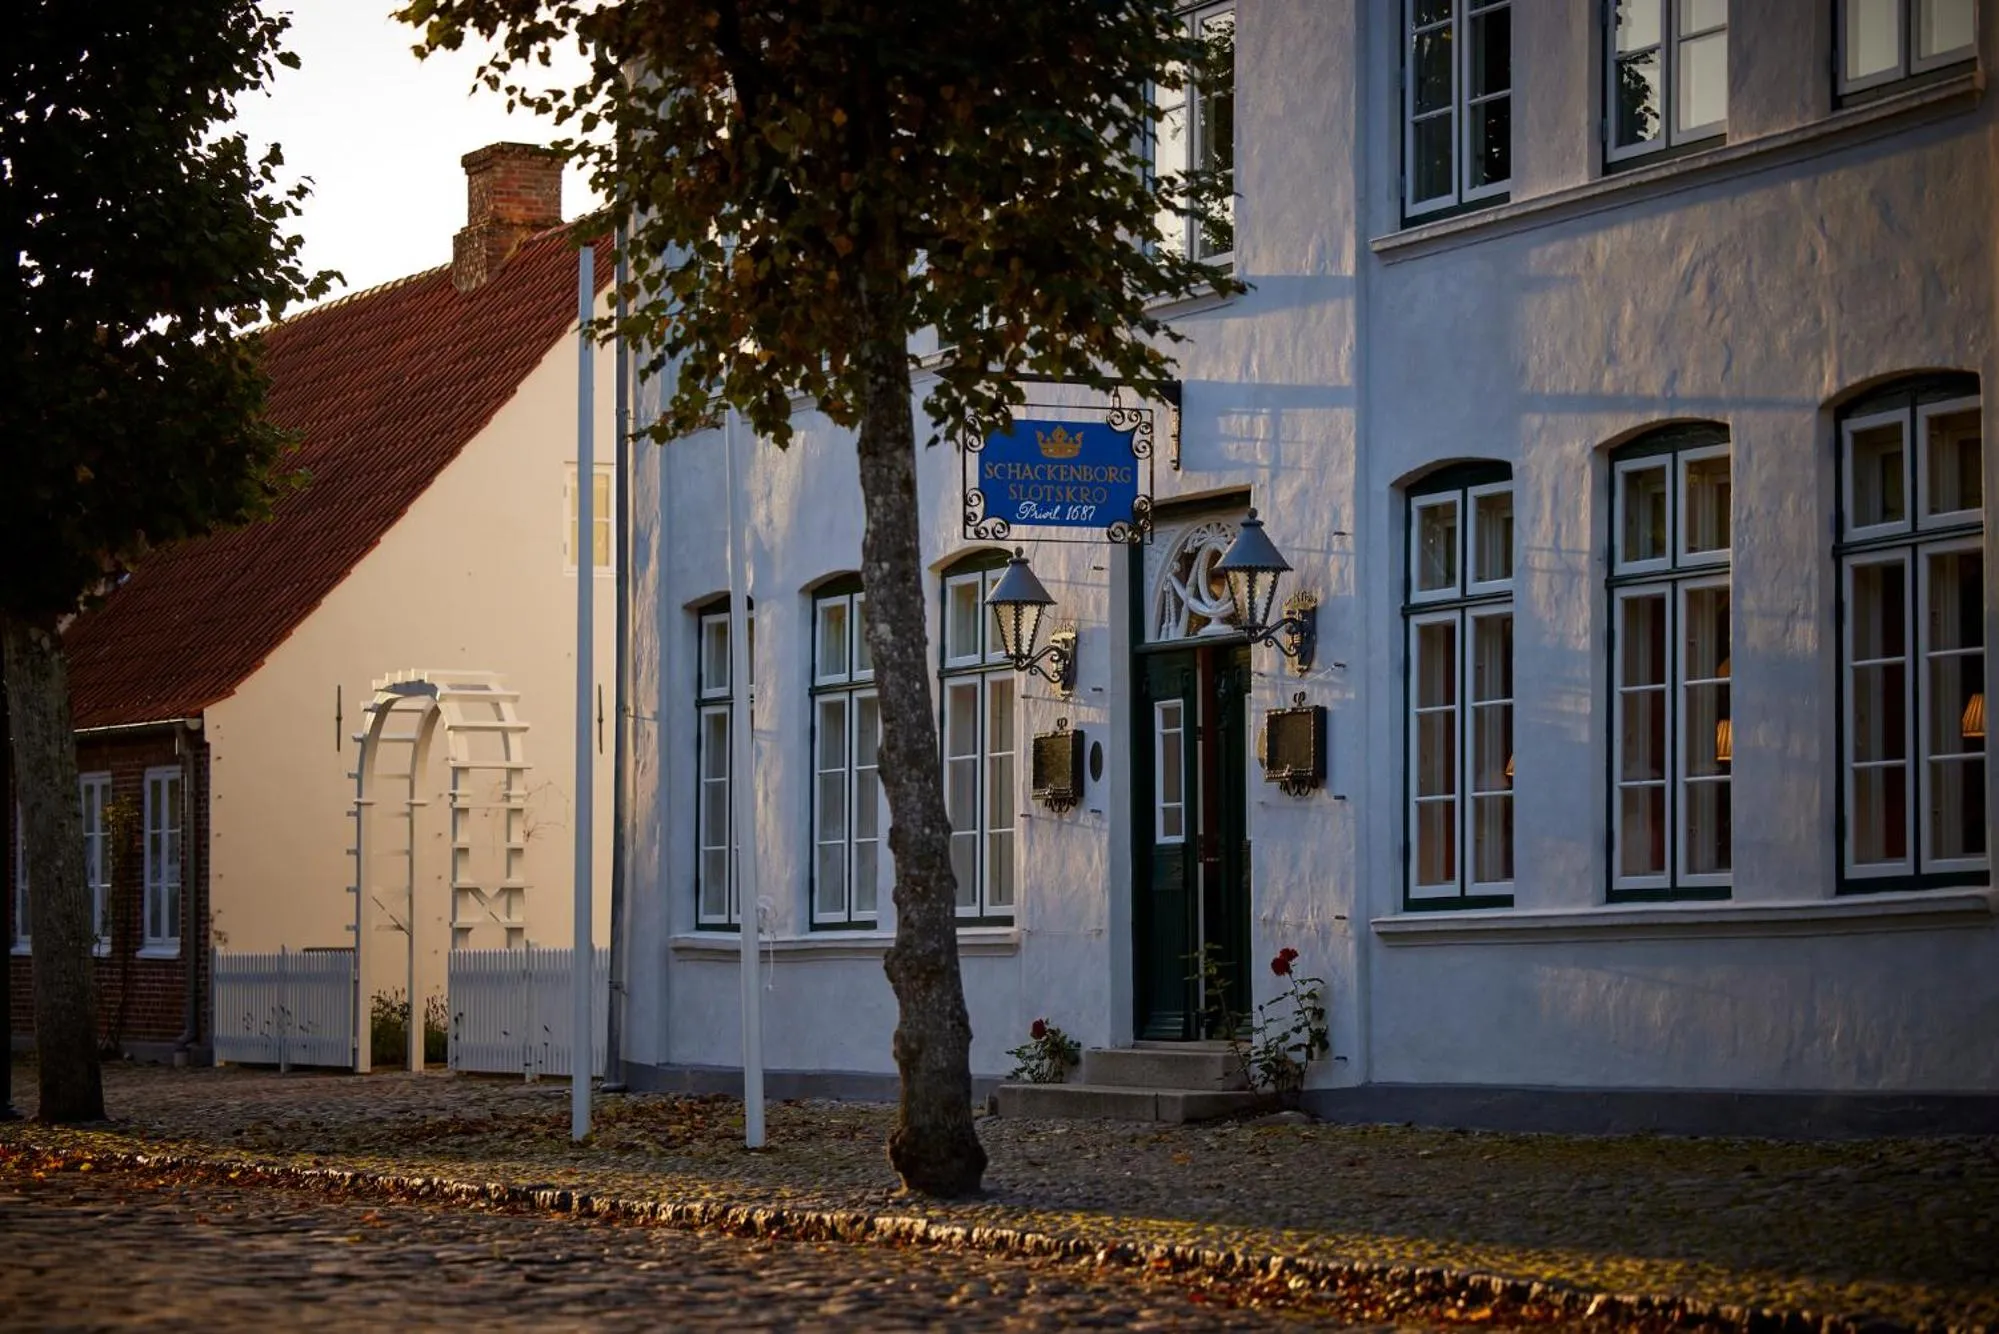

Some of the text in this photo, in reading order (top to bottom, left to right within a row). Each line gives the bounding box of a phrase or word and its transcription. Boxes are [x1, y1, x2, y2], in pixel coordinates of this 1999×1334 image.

[984, 462, 1132, 483] SCHACKENBORG
[1008, 484, 1108, 504] SLOTSKRO
[1065, 504, 1096, 521] 1687
